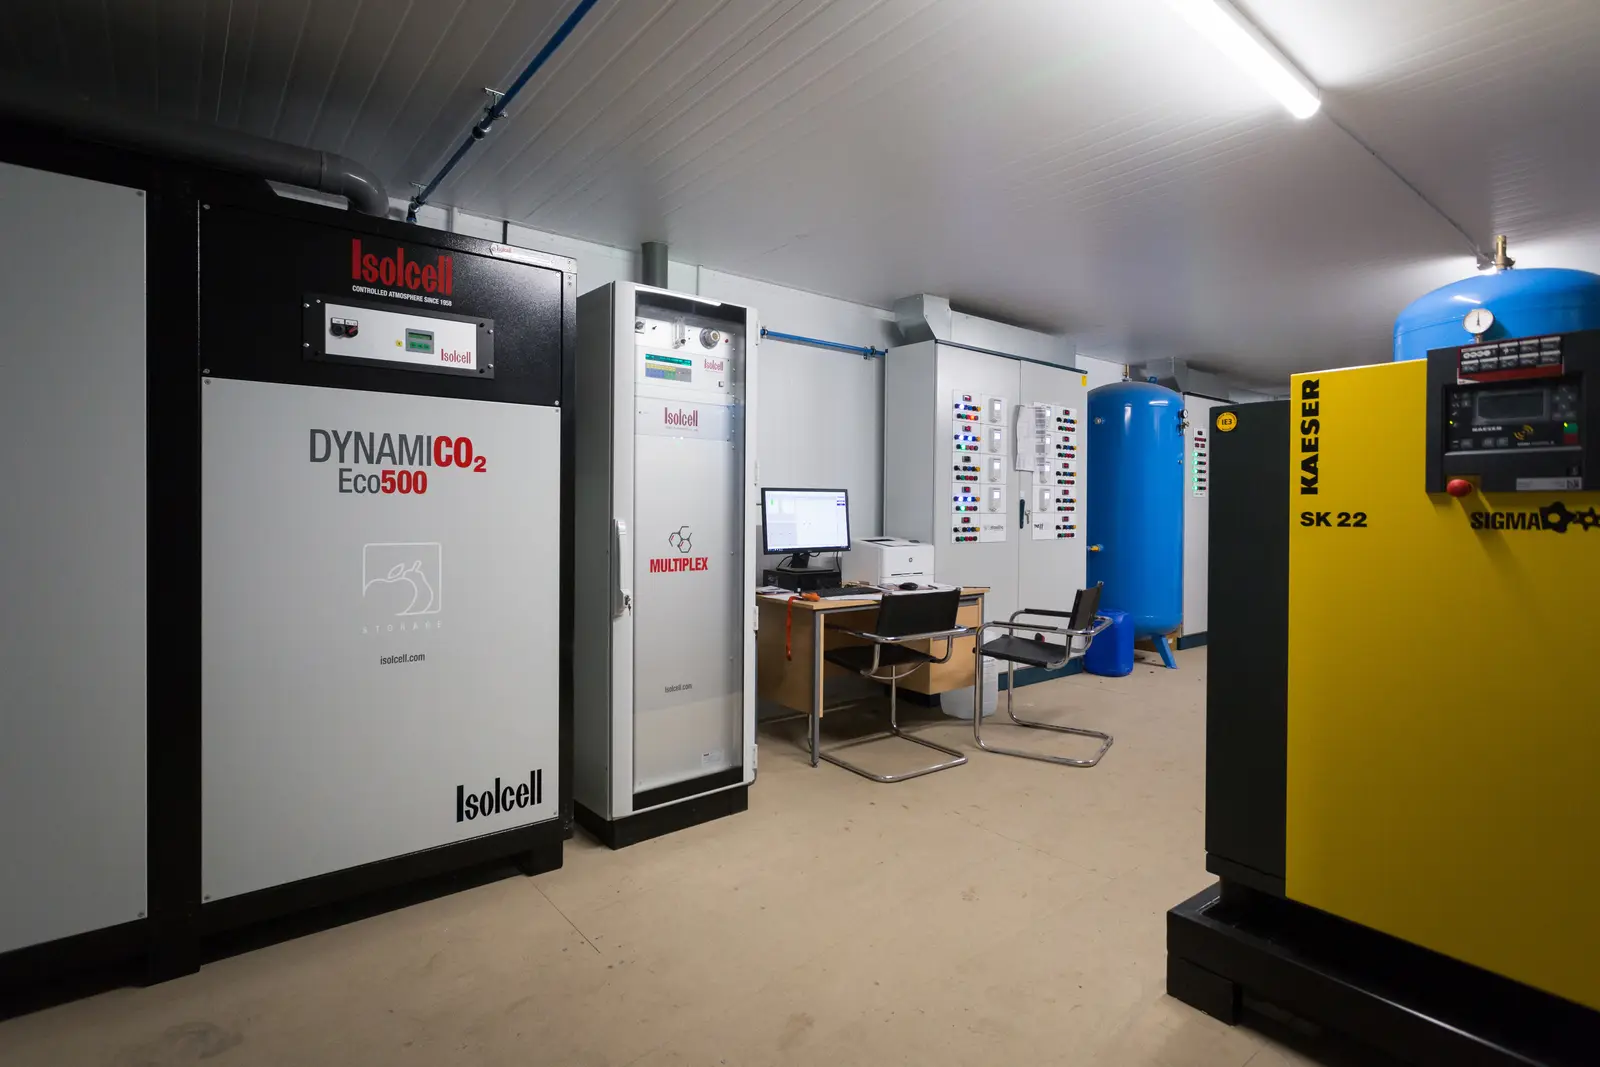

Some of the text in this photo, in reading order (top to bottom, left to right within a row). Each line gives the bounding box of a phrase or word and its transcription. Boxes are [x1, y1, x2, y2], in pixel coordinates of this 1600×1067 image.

[352, 238, 453, 297] Isolcell
[352, 285, 453, 307] CONTROLLED ATMOSPHERE SINCE 1958
[440, 348, 472, 364] Isolcell
[704, 358, 724, 371] Isolcell
[664, 406, 698, 427] Isolcell
[1221, 418, 1233, 426] IE3
[1300, 378, 1320, 495] KAESER
[338, 467, 428, 494] Eco500
[1300, 511, 1368, 528] SK 22
[1470, 510, 1541, 531] SIGMA
[649, 556, 709, 573] MULTIPLEX
[380, 653, 426, 665] isolcell.com
[456, 768, 542, 823] Isolcell
